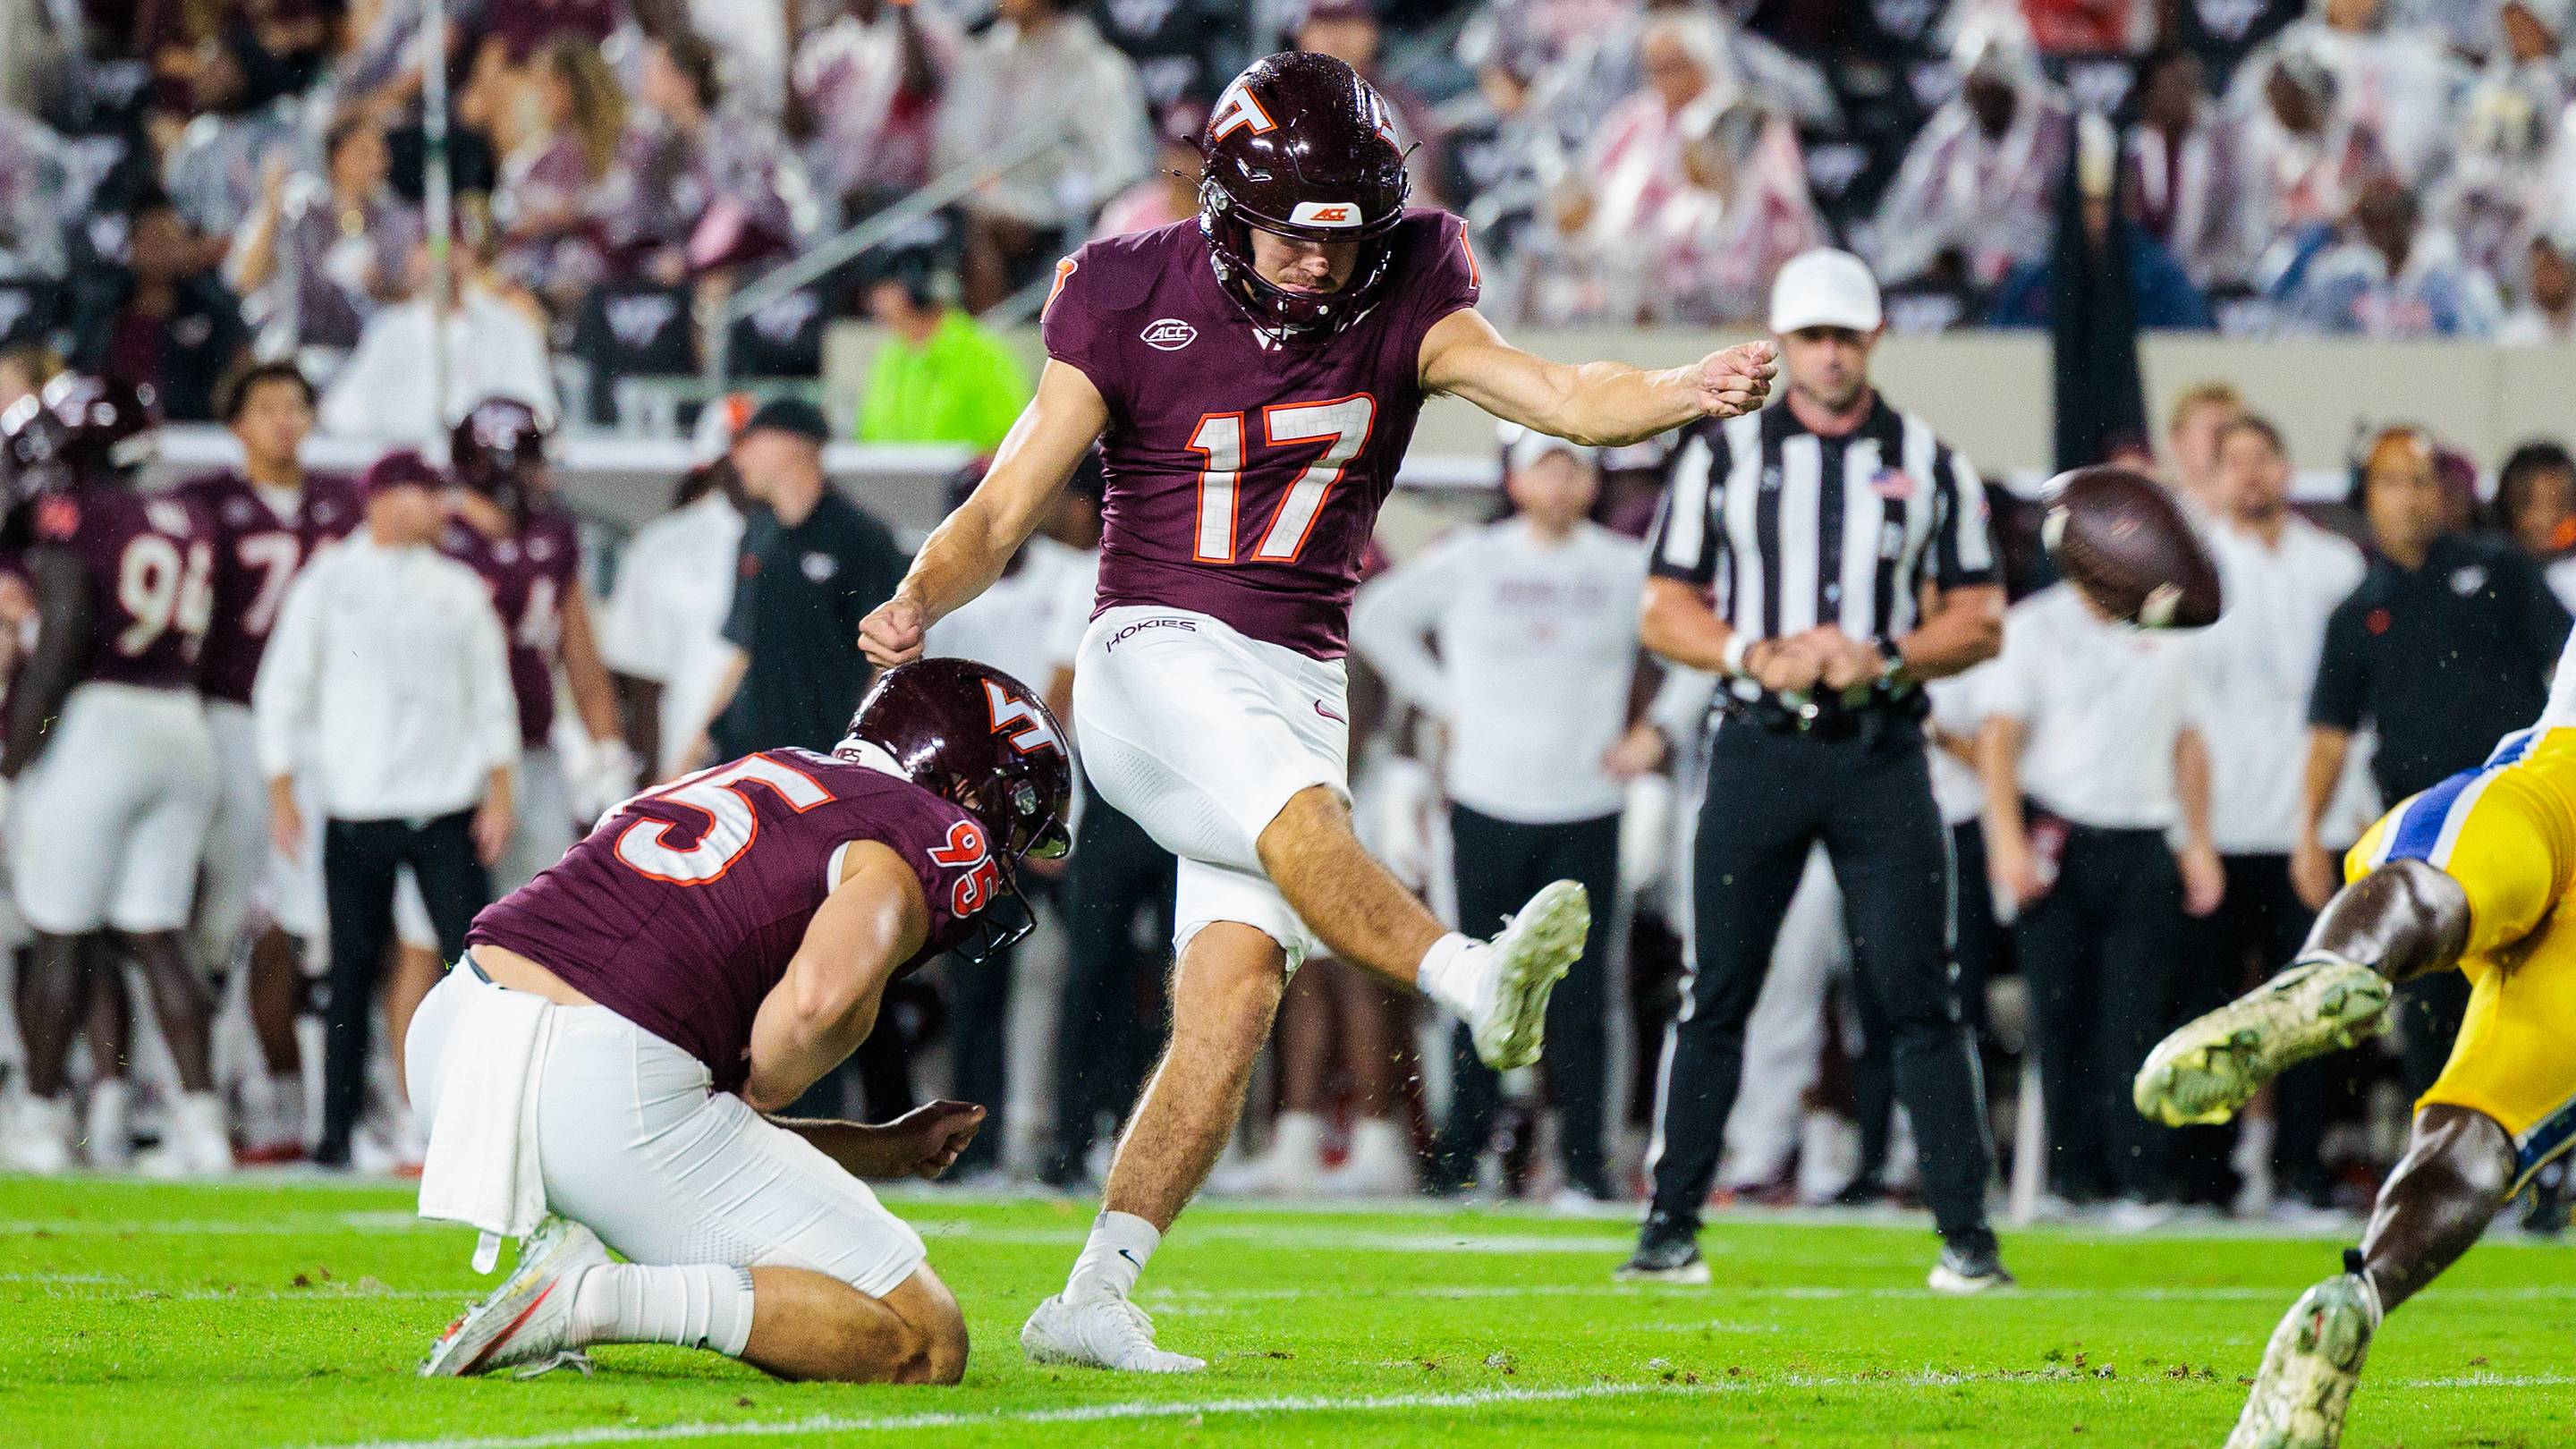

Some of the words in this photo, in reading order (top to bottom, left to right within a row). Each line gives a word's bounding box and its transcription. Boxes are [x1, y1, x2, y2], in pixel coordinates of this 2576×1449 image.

[1309, 208, 1349, 222] ACC
[1183, 392, 1377, 564] 17
[1106, 619, 1197, 654] HOKIES
[927, 818, 1000, 920] 95
